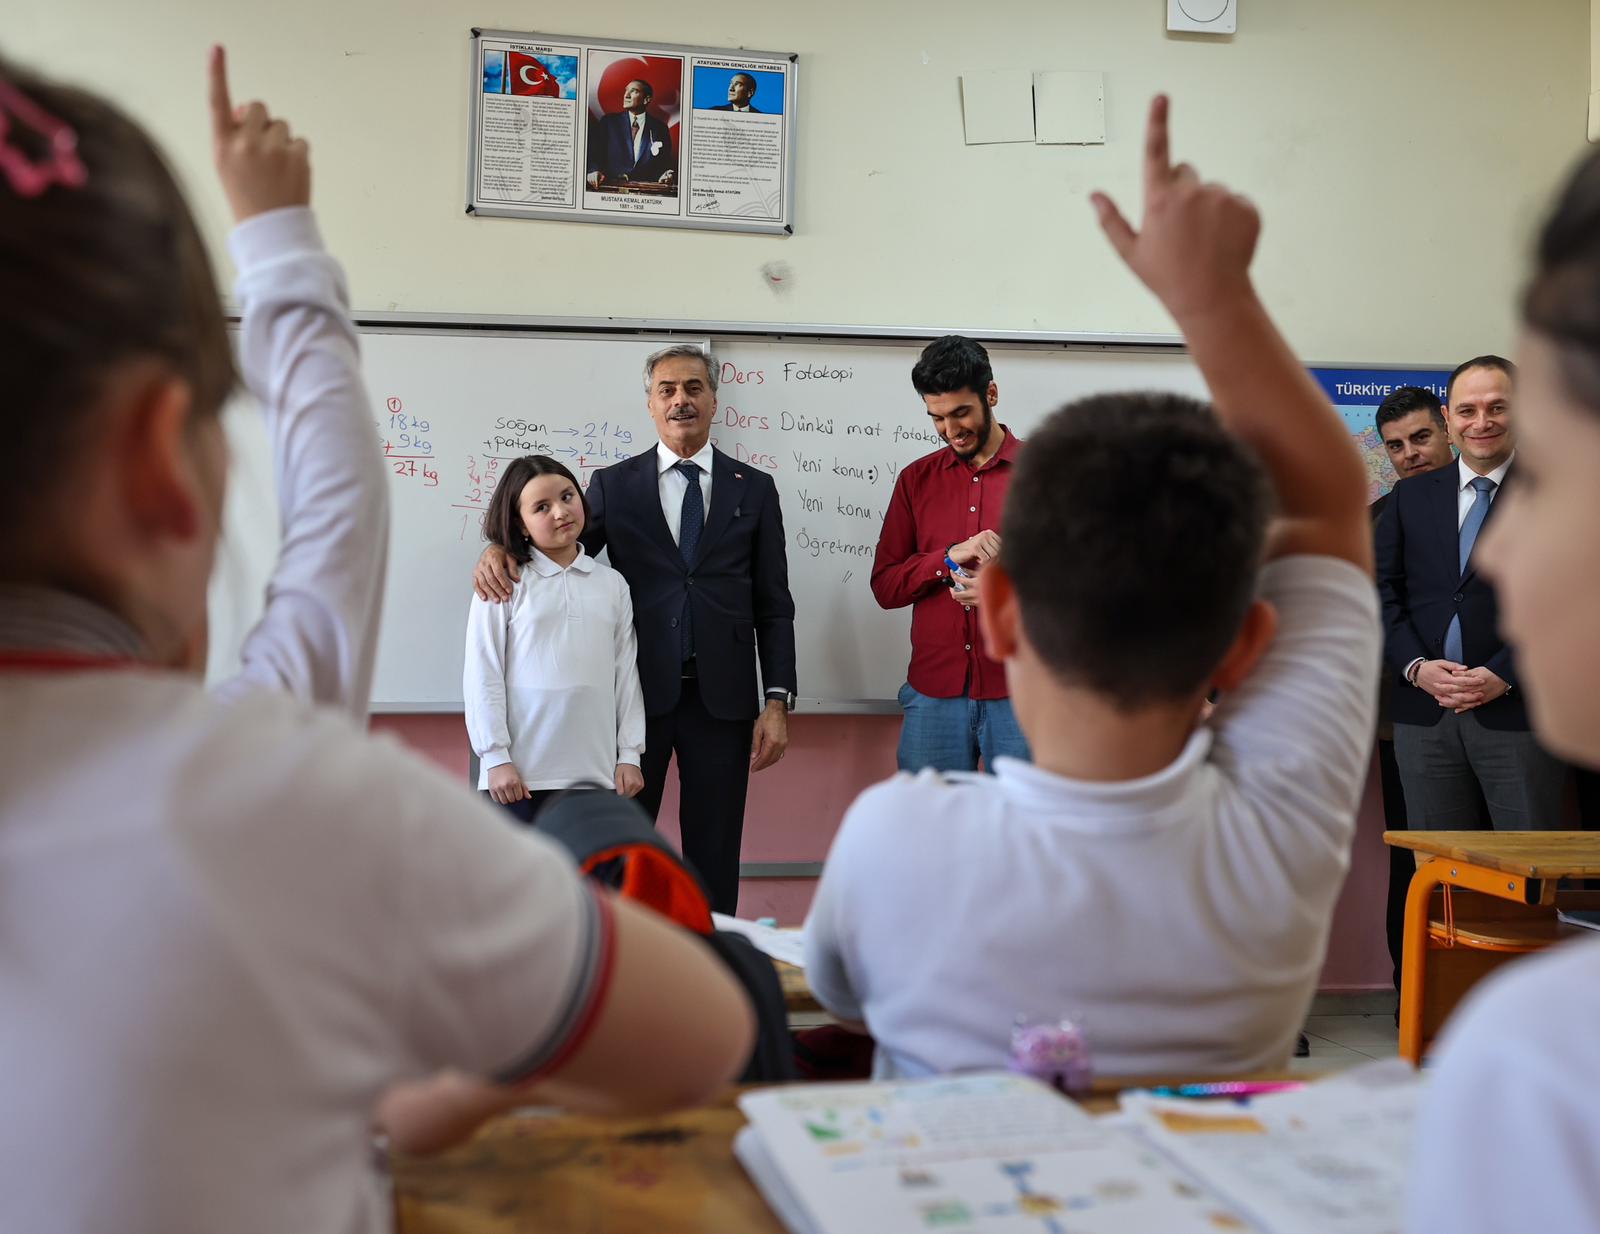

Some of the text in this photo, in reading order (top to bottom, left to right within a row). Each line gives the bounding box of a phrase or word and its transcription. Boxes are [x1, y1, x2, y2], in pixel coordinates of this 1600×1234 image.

[721, 362, 853, 384] Ders Fotokopi
[1336, 382, 1391, 396] TÜRKİYE
[614, 425, 633, 444] kg
[725, 406, 946, 448] Ders Dünkü mat fotokop
[584, 442, 608, 460] 24
[736, 442, 778, 469] Ders
[792, 450, 822, 473] Yeni
[393, 460, 438, 486] 27 kg
[798, 489, 823, 513] Yeni
[837, 496, 872, 519] konu
[796, 528, 874, 557] Öğretmen
